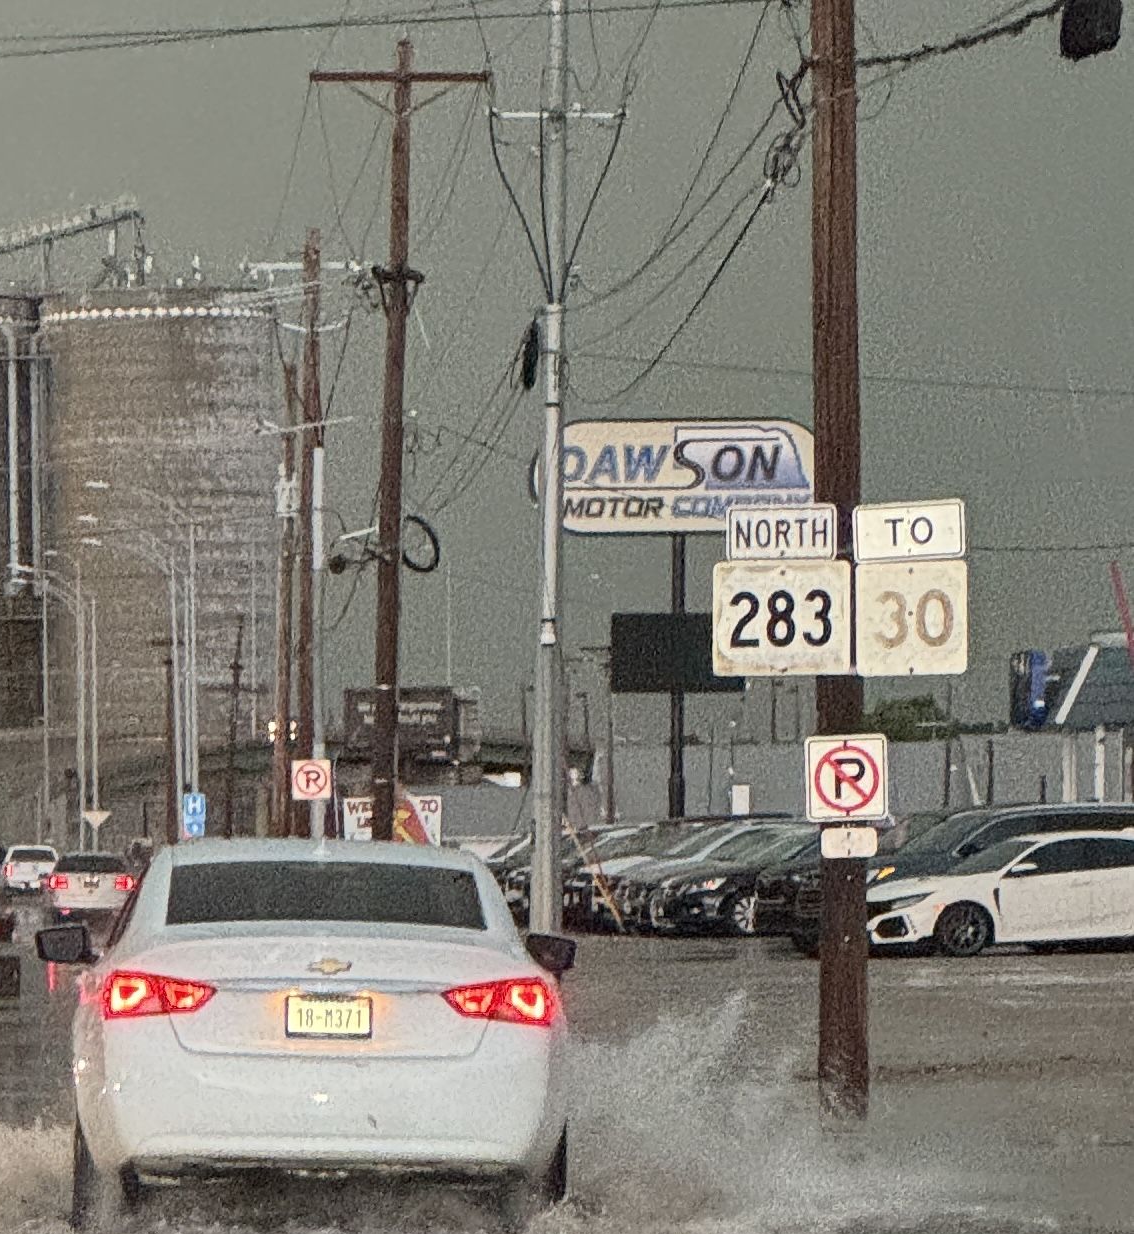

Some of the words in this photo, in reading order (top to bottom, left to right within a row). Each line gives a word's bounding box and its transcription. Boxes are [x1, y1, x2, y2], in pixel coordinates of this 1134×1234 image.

[563, 438, 783, 488] DAWSON
[564, 496, 664, 518] MOTOR
[735, 518, 829, 549] NORTH
[884, 516, 934, 546] TO
[729, 588, 832, 648] 283
[874, 588, 954, 649] 30
[297, 1007, 362, 1029] 18-M371
